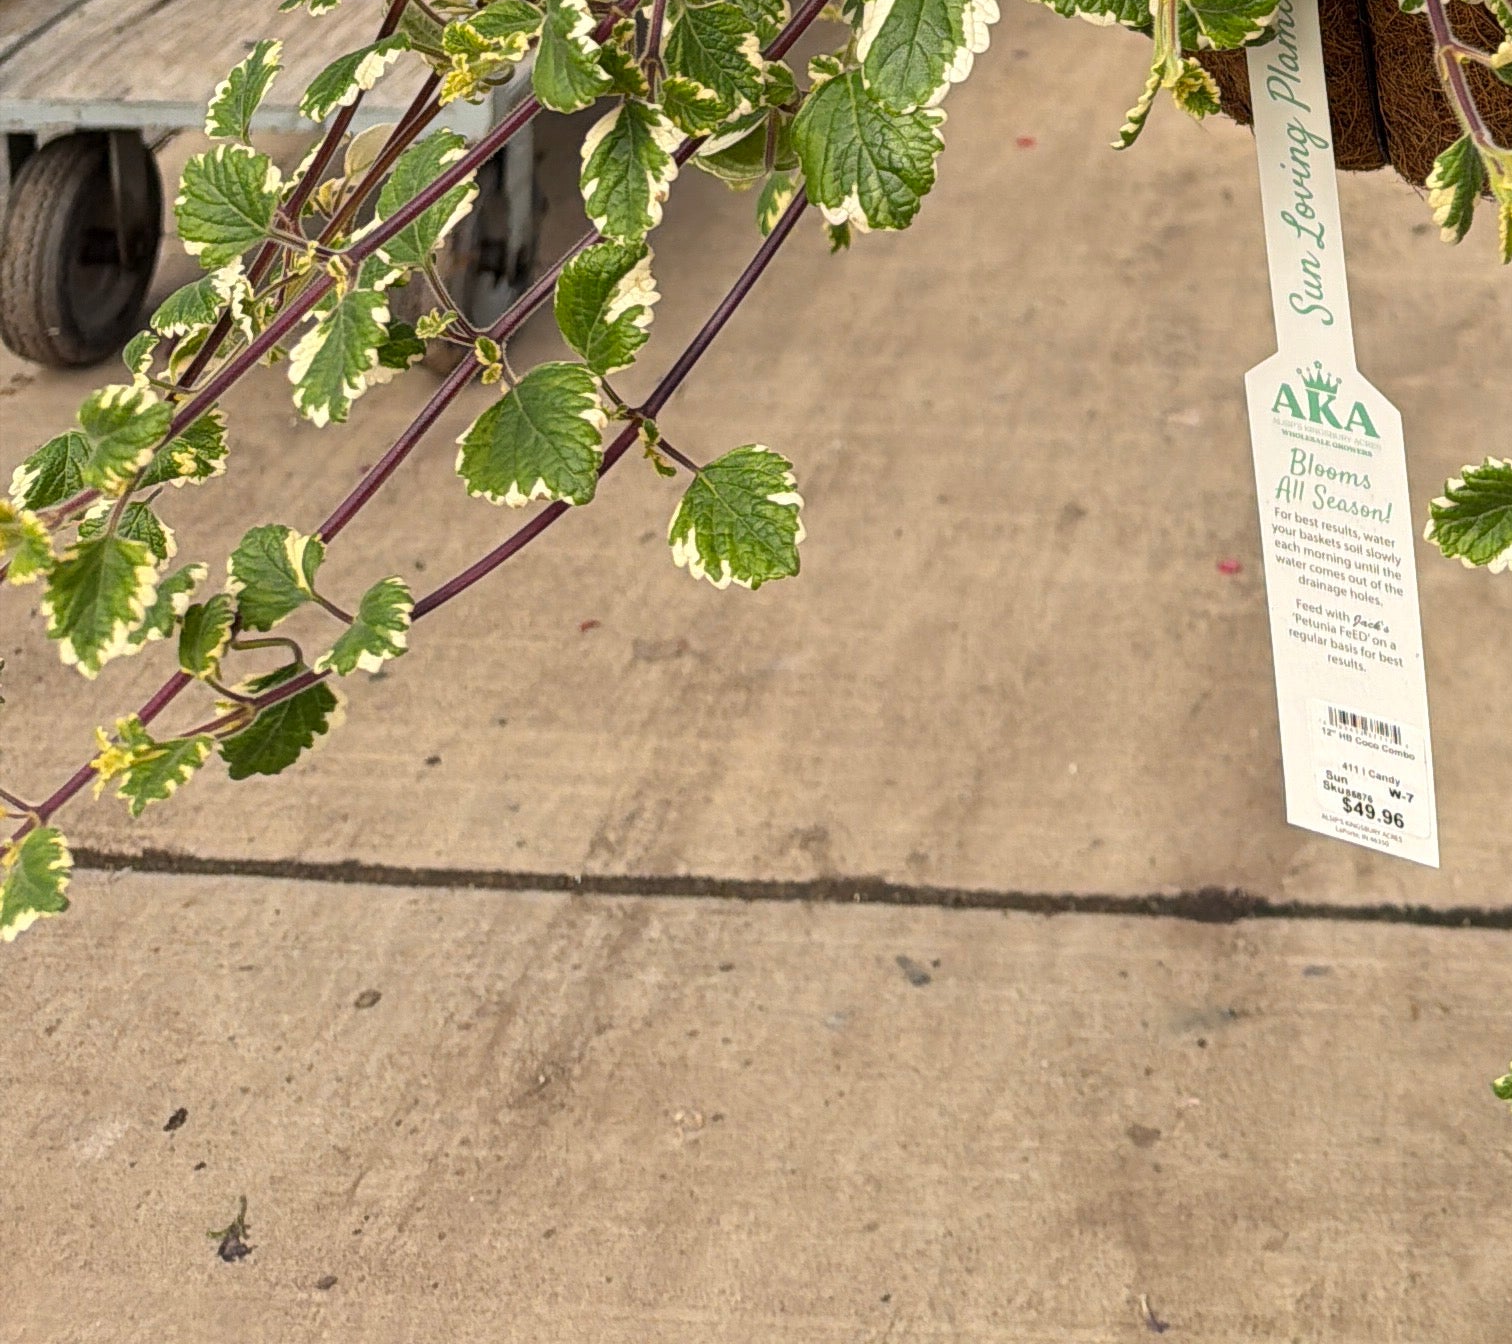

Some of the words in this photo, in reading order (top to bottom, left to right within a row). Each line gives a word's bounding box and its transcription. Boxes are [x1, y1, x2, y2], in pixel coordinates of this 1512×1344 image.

[1280, 116, 1329, 250] Loving
[1288, 251, 1334, 327] Sun
[1271, 382, 1381, 439] AKA
[1280, 428, 1332, 448] WHOLESALE
[1331, 441, 1373, 458] GROWERS
[1290, 447, 1372, 490] Blooms
[1275, 475, 1305, 503] All
[1311, 483, 1393, 525] Season!
[1271, 522, 1297, 536] your
[1299, 527, 1342, 550] baskets
[1343, 542, 1363, 556] soil
[1365, 547, 1402, 568] slowly
[1274, 506, 1292, 521] For
[1294, 511, 1319, 529] best
[1321, 521, 1361, 541] results,
[1363, 531, 1396, 549] water
[1274, 539, 1300, 554] each
[1303, 546, 1352, 570] morning
[1354, 560, 1380, 576] until
[1382, 566, 1402, 581] the
[1275, 553, 1307, 571] water
[1309, 562, 1346, 582] comes
[1348, 574, 1368, 588] out
[1370, 579, 1383, 591] of
[1384, 582, 1404, 598] the
[1298, 574, 1348, 598] drainage
[1350, 587, 1384, 608] holes.
[1296, 598, 1323, 616] Feed
[1325, 608, 1351, 623] with
[1352, 614, 1390, 634] Jack's
[1288, 628, 1328, 647] regular
[1330, 637, 1359, 655] basis
[1361, 646, 1377, 660] for
[1379, 651, 1404, 668] best
[1327, 654, 1367, 673] results.
[1371, 637, 1388, 649] on
[1389, 641, 1398, 652] a
[1355, 736, 1380, 751] Coco
[1381, 744, 1416, 761] Combo
[1325, 769, 1349, 786] Sun
[1368, 768, 1401, 788] Candy
[1388, 787, 1415, 804] W-7
[1342, 796, 1405, 830] $49.96
